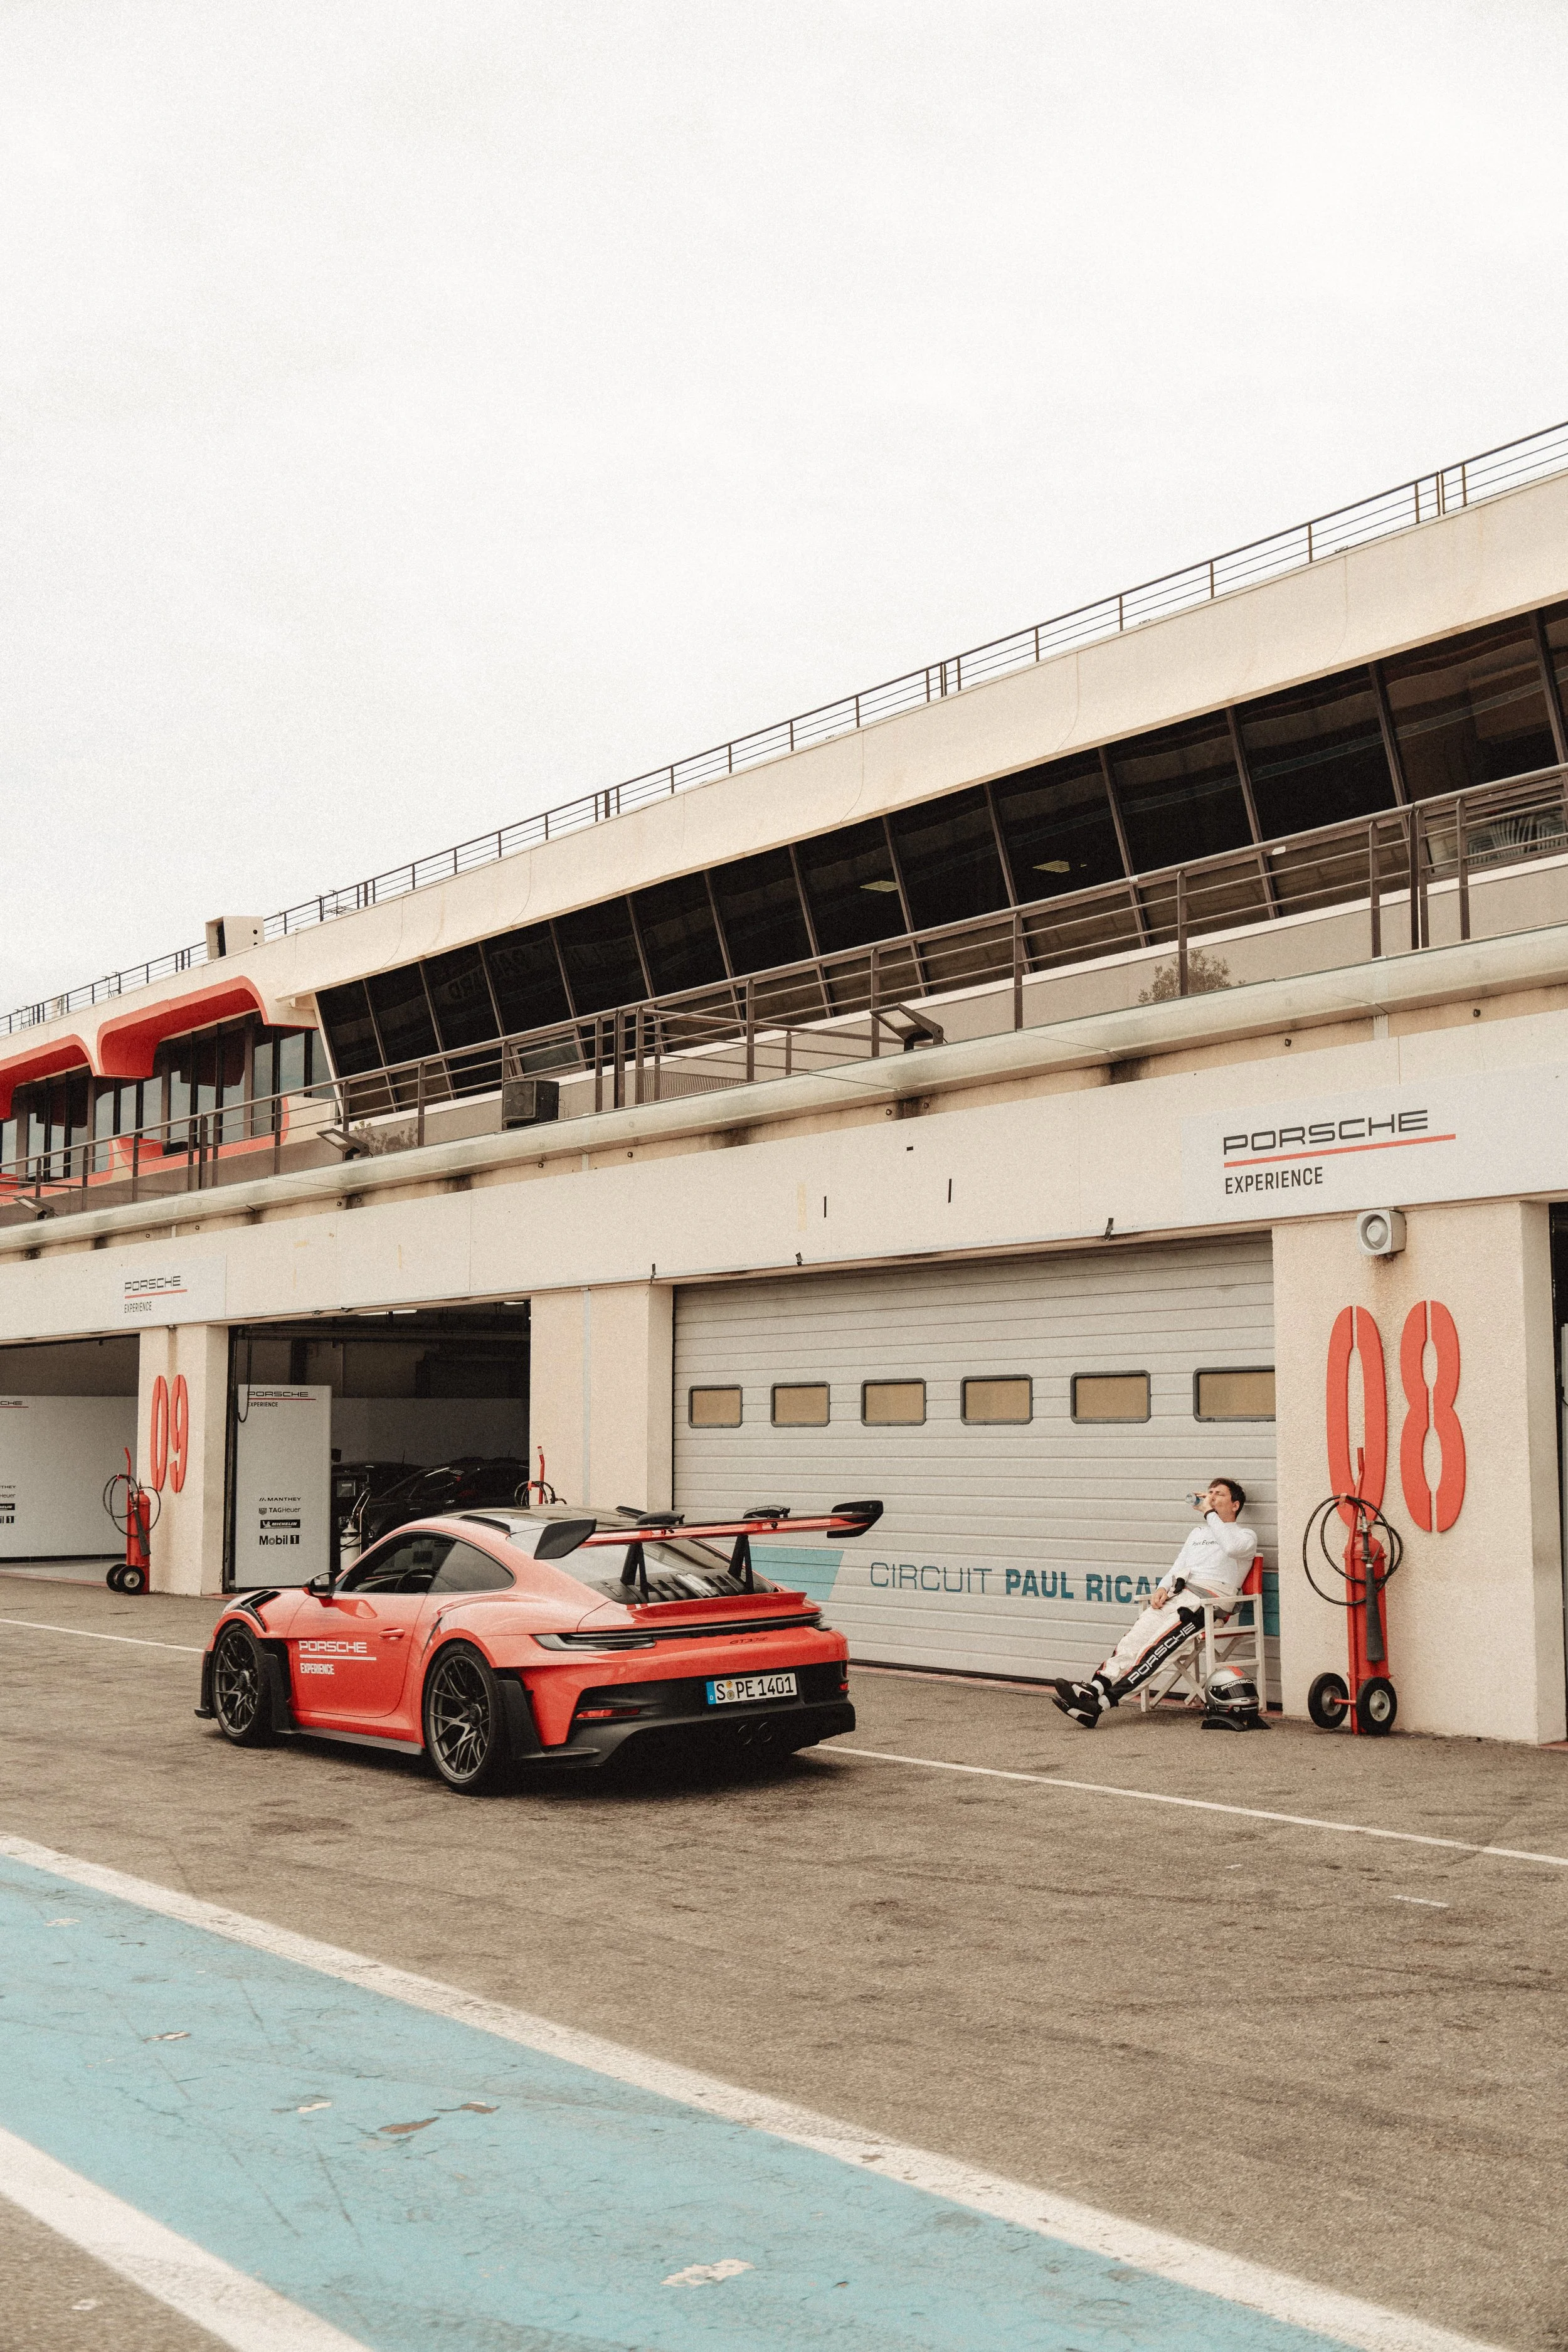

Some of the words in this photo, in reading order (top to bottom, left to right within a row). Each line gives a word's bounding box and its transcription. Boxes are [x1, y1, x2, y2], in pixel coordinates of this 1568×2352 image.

[1223, 1109, 1428, 1155] PORSCHE
[1225, 1166, 1323, 1195] EXPERIENCE
[124, 1275, 181, 1293] PORSCHE
[124, 1301, 152, 1313] EXPERIENCE
[1326, 1300, 1466, 1533] 08
[150, 1374, 189, 1493] 09
[259, 1535, 288, 1545] Mobil
[870, 1562, 993, 1594] CIRCUIT
[1005, 1568, 1074, 1599] PAUL
[1086, 1573, 1163, 1604] RICA
[298, 1640, 368, 1653] PORSCHE
[1127, 1621, 1196, 1685] PORSCHE
[300, 1663, 336, 1675] EXPERIENCE
[716, 1683, 726, 1701] S
[735, 1680, 755, 1699] PE
[758, 1676, 794, 1697] 1401
